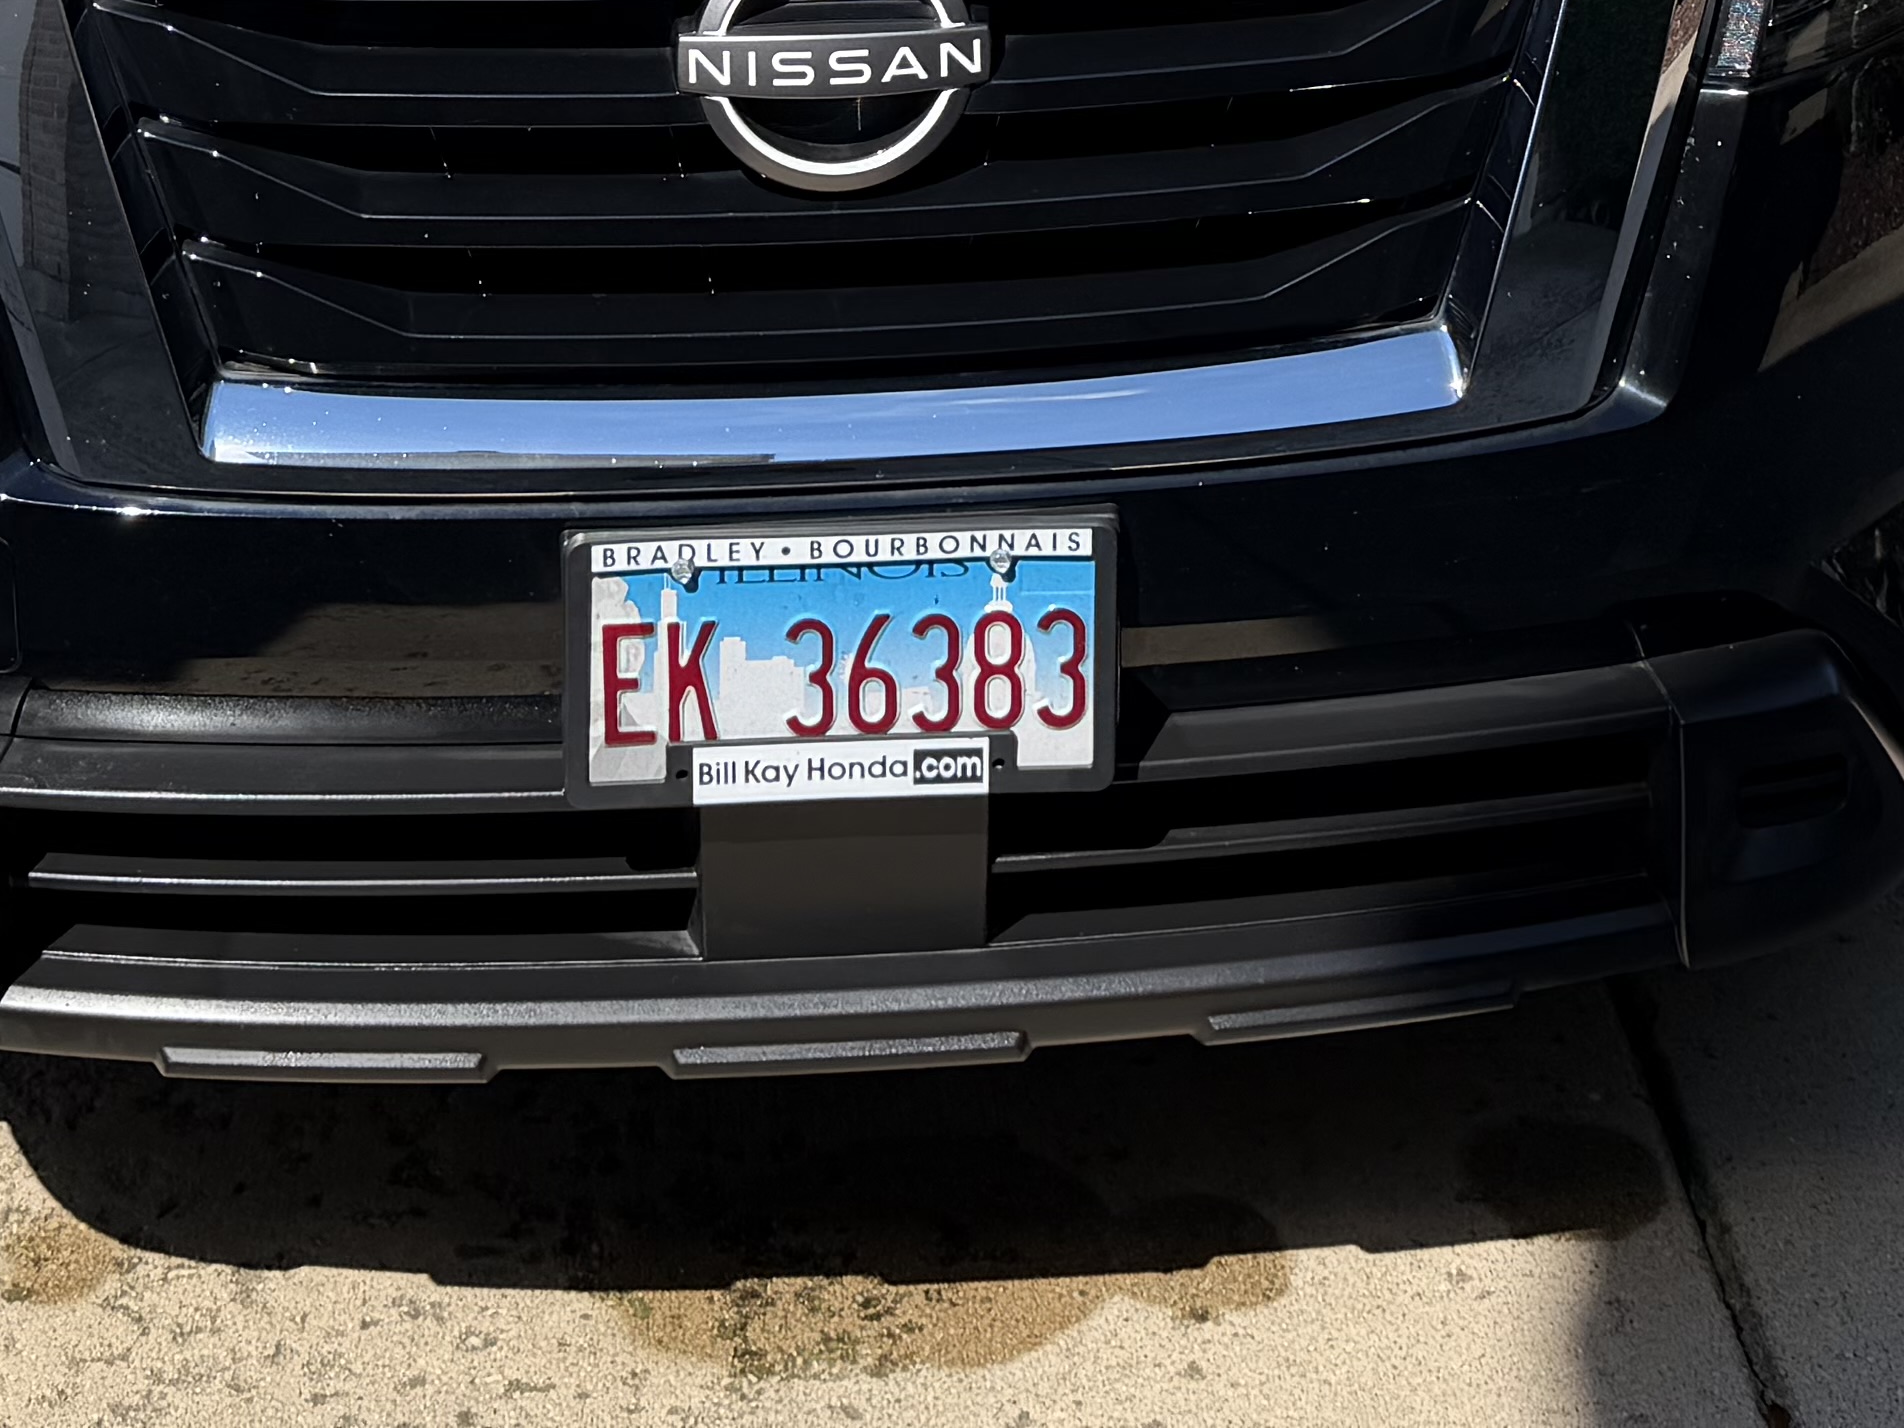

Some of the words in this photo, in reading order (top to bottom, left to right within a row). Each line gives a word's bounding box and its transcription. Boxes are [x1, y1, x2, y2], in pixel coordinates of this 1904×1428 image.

[688, 38, 982, 87] NISSAN
[602, 541, 765, 568] BRADLEY
[809, 531, 1081, 560] BOURBONNAIS
[601, 619, 719, 746] EK
[784, 608, 1089, 738] 36383
[698, 761, 737, 786] Bill
[744, 759, 800, 788] Kay
[807, 755, 909, 782] Honda
[914, 755, 983, 779] .com
